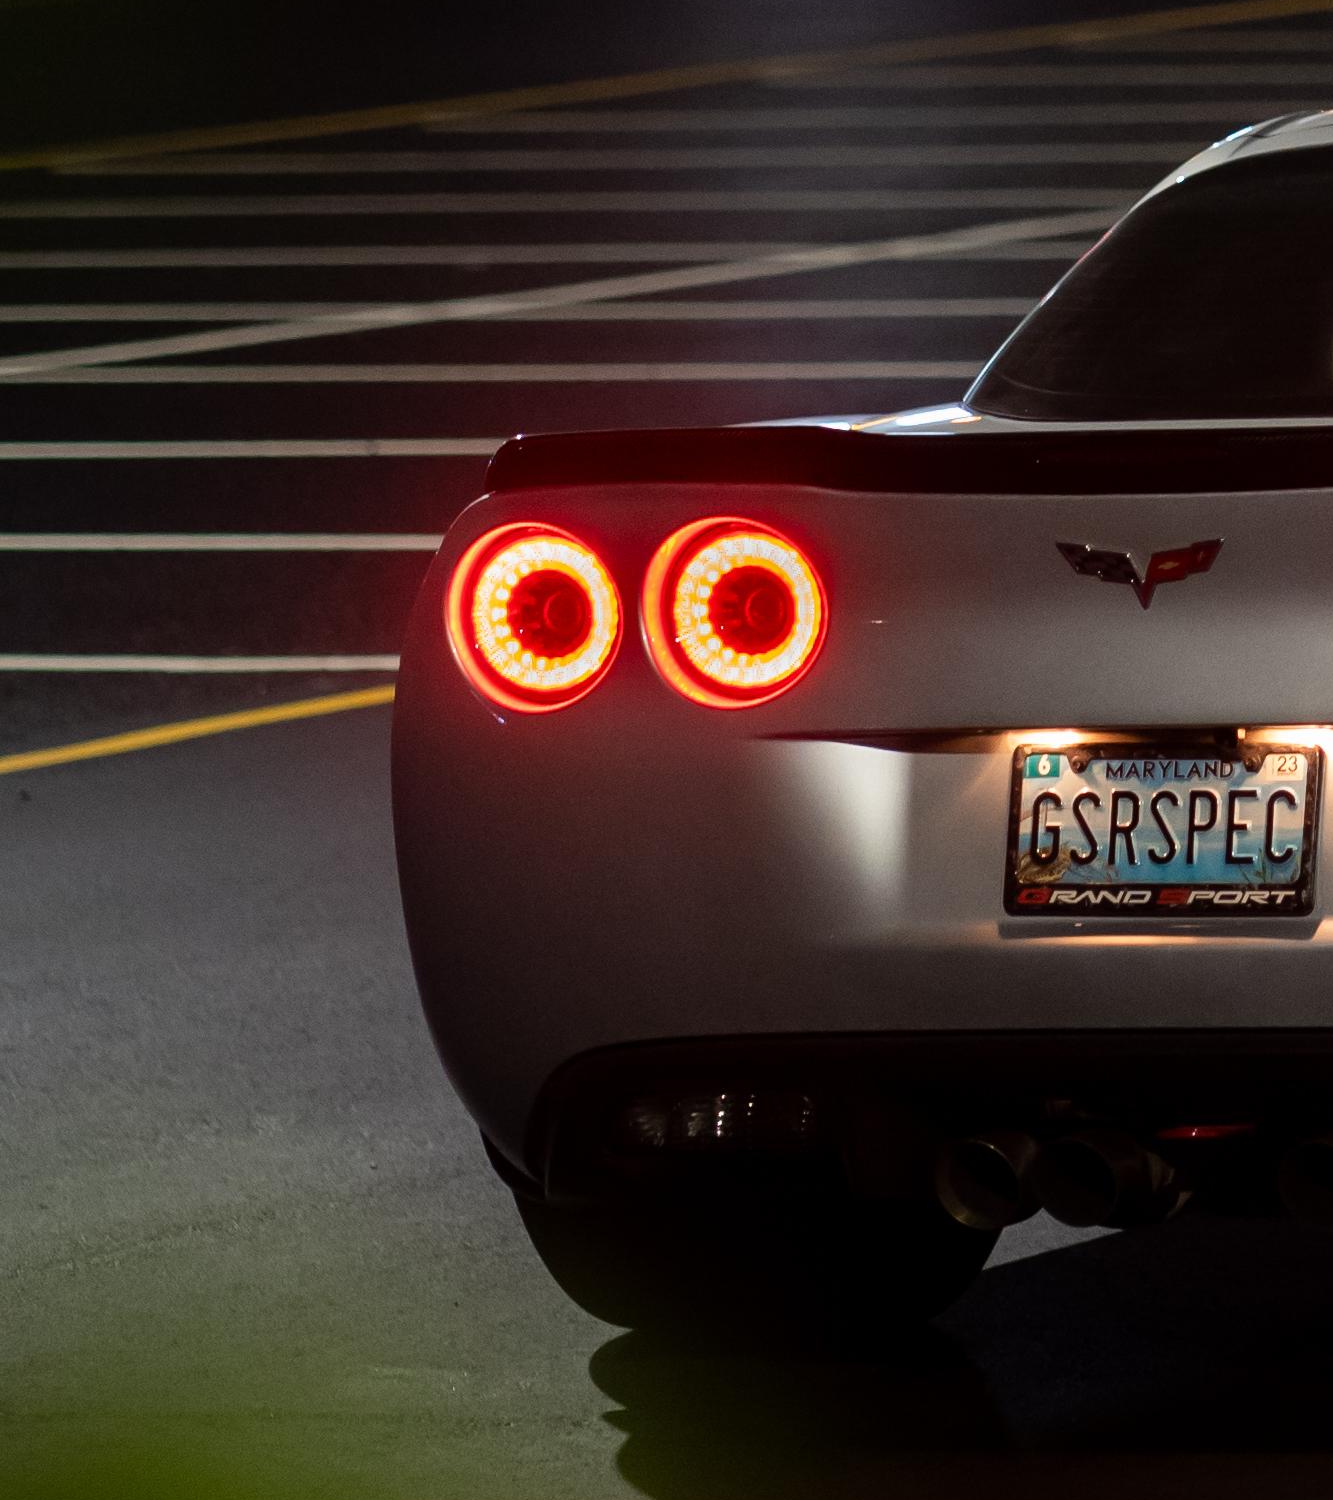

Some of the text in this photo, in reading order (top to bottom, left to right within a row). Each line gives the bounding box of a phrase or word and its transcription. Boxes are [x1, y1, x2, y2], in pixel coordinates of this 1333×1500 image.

[1038, 753, 1051, 776] 6
[1105, 760, 1234, 779] MARYLAND
[1277, 756, 1298, 773] 23
[1029, 790, 1298, 865] GSRSPEC
[1017, 888, 1296, 904] GRAND SPORT
